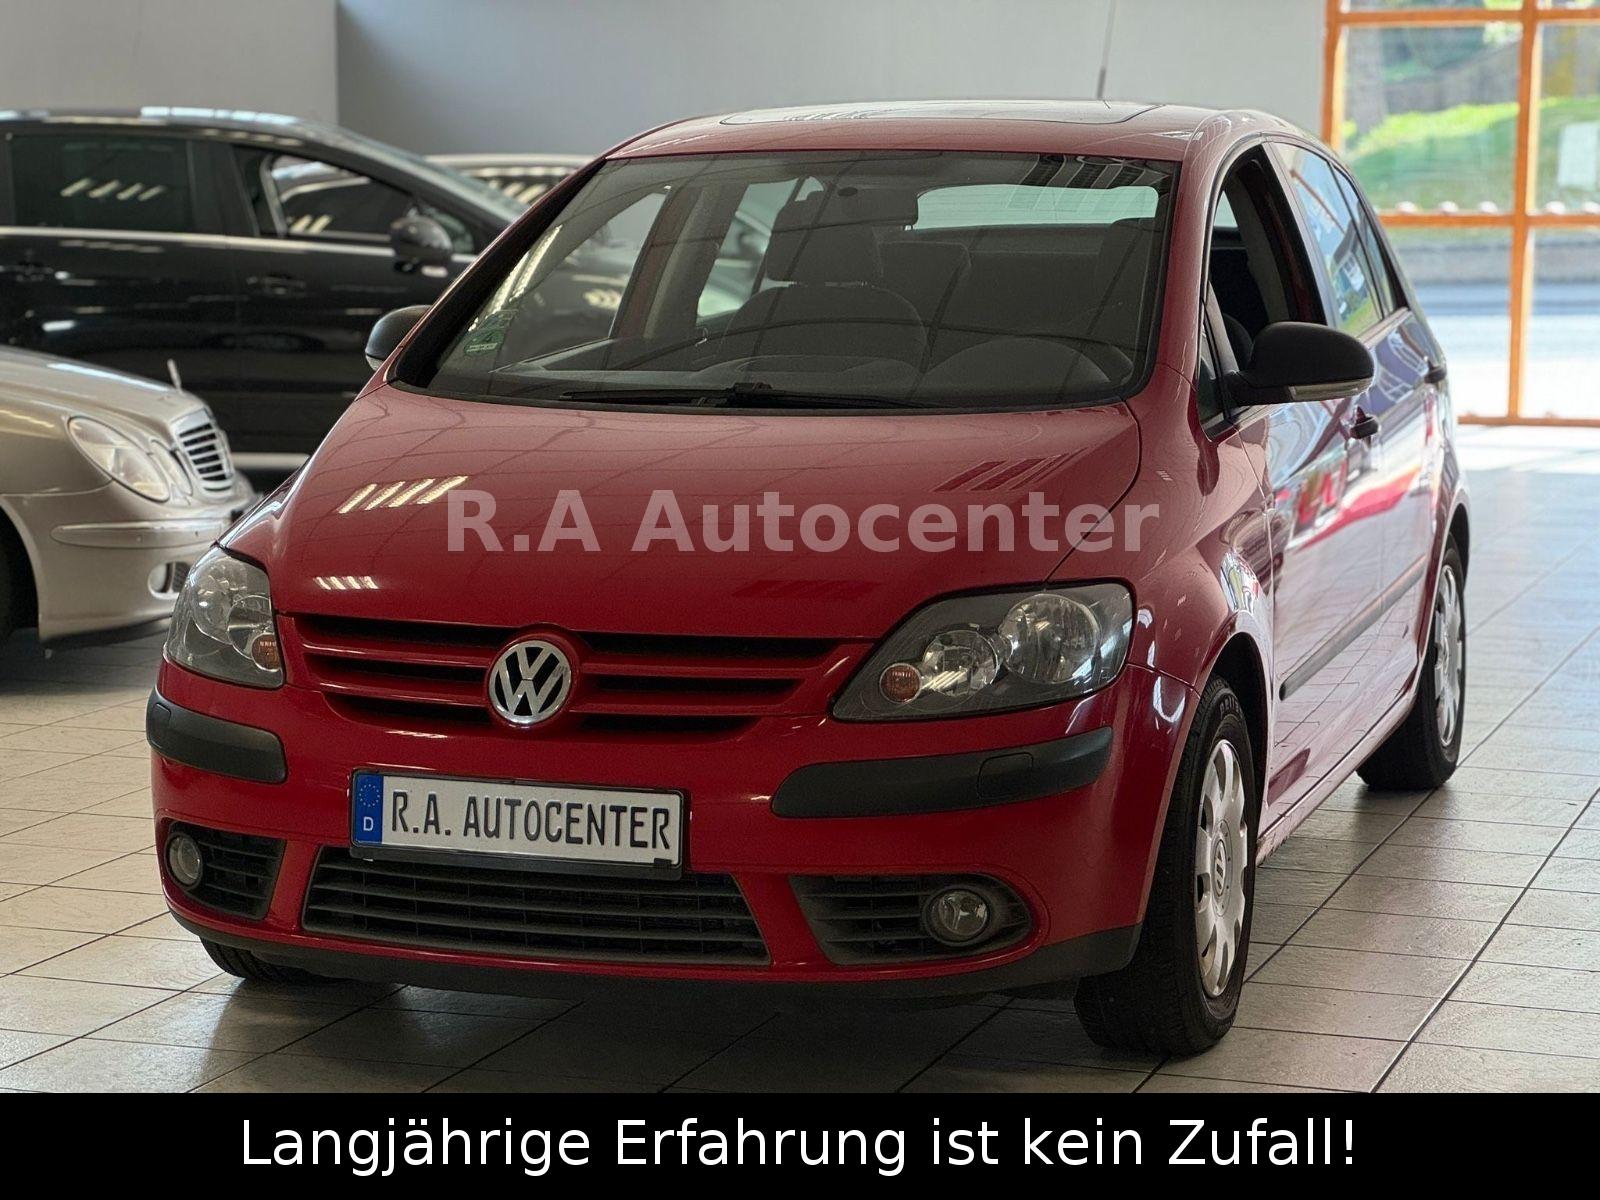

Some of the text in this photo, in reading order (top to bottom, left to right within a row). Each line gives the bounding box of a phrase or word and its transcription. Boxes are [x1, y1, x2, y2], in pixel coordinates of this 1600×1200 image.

[489, 639, 573, 725] VW
[362, 815, 374, 832] D
[391, 790, 671, 851] R.A. AUTOCENTER
